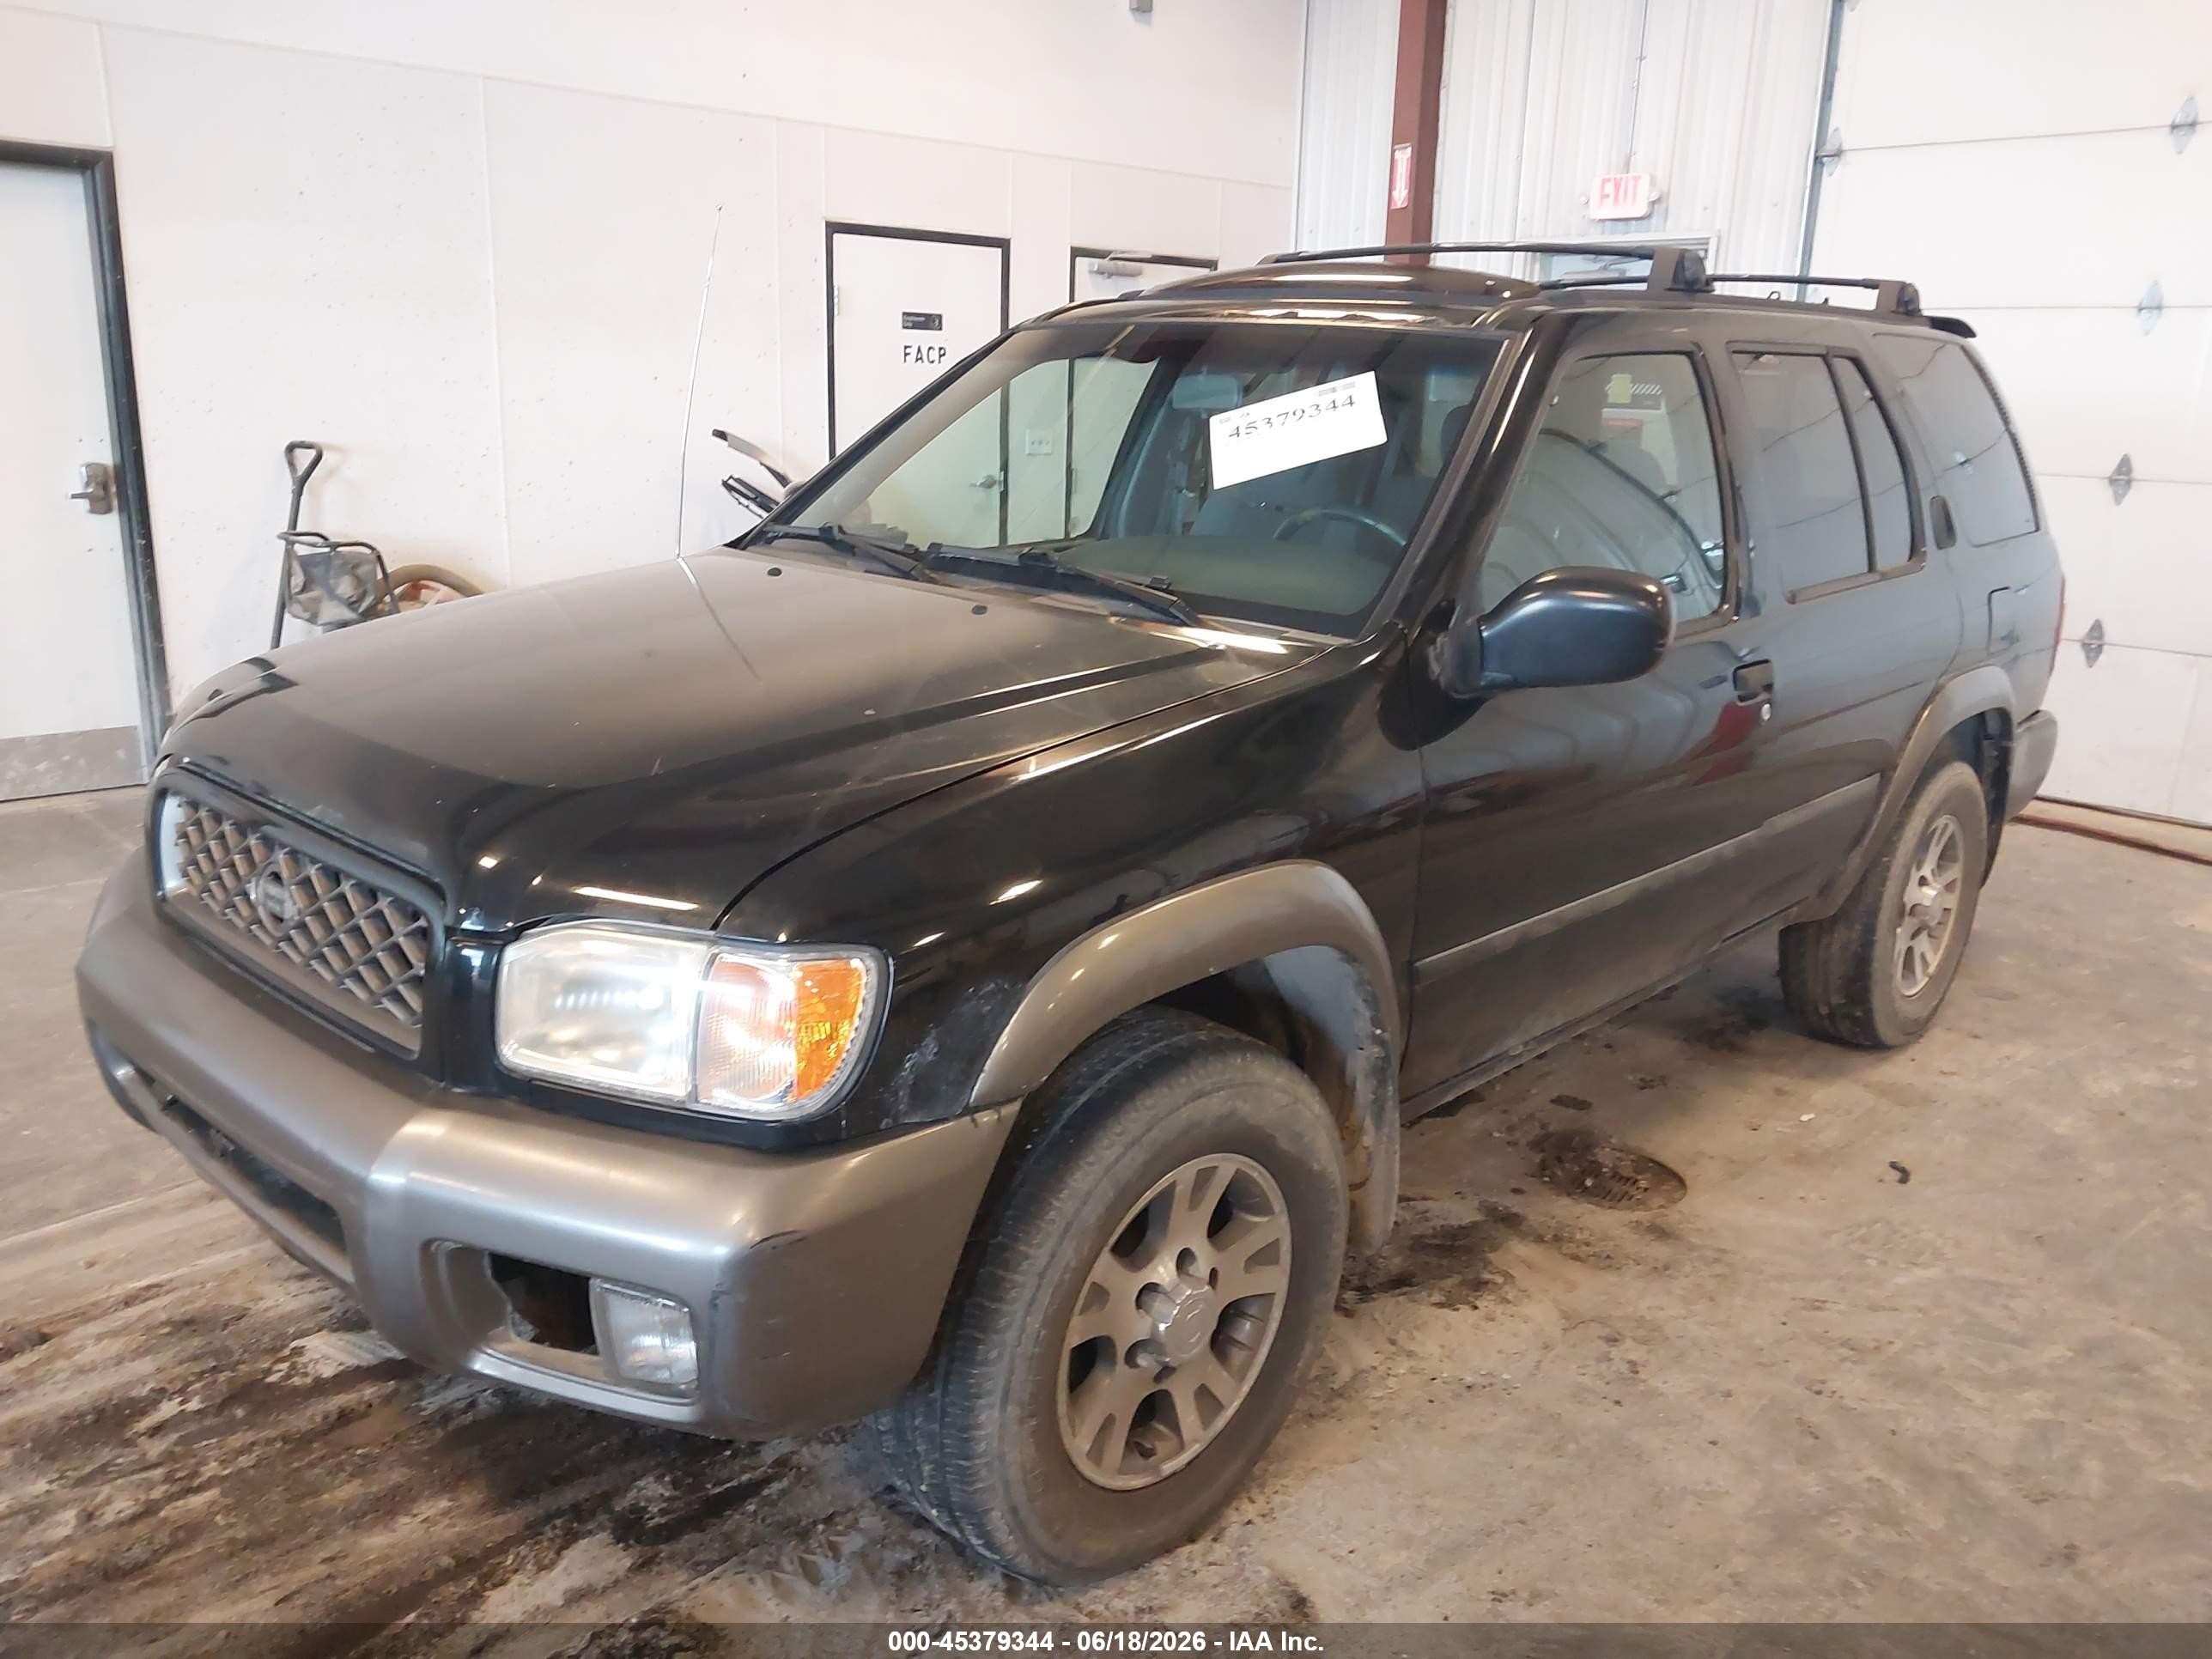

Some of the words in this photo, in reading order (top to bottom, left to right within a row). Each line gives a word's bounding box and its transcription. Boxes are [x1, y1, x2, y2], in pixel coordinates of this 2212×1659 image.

[1600, 175, 1642, 209] EXIT
[903, 345, 946, 364] FACP
[1229, 394, 1355, 439] 45379344
